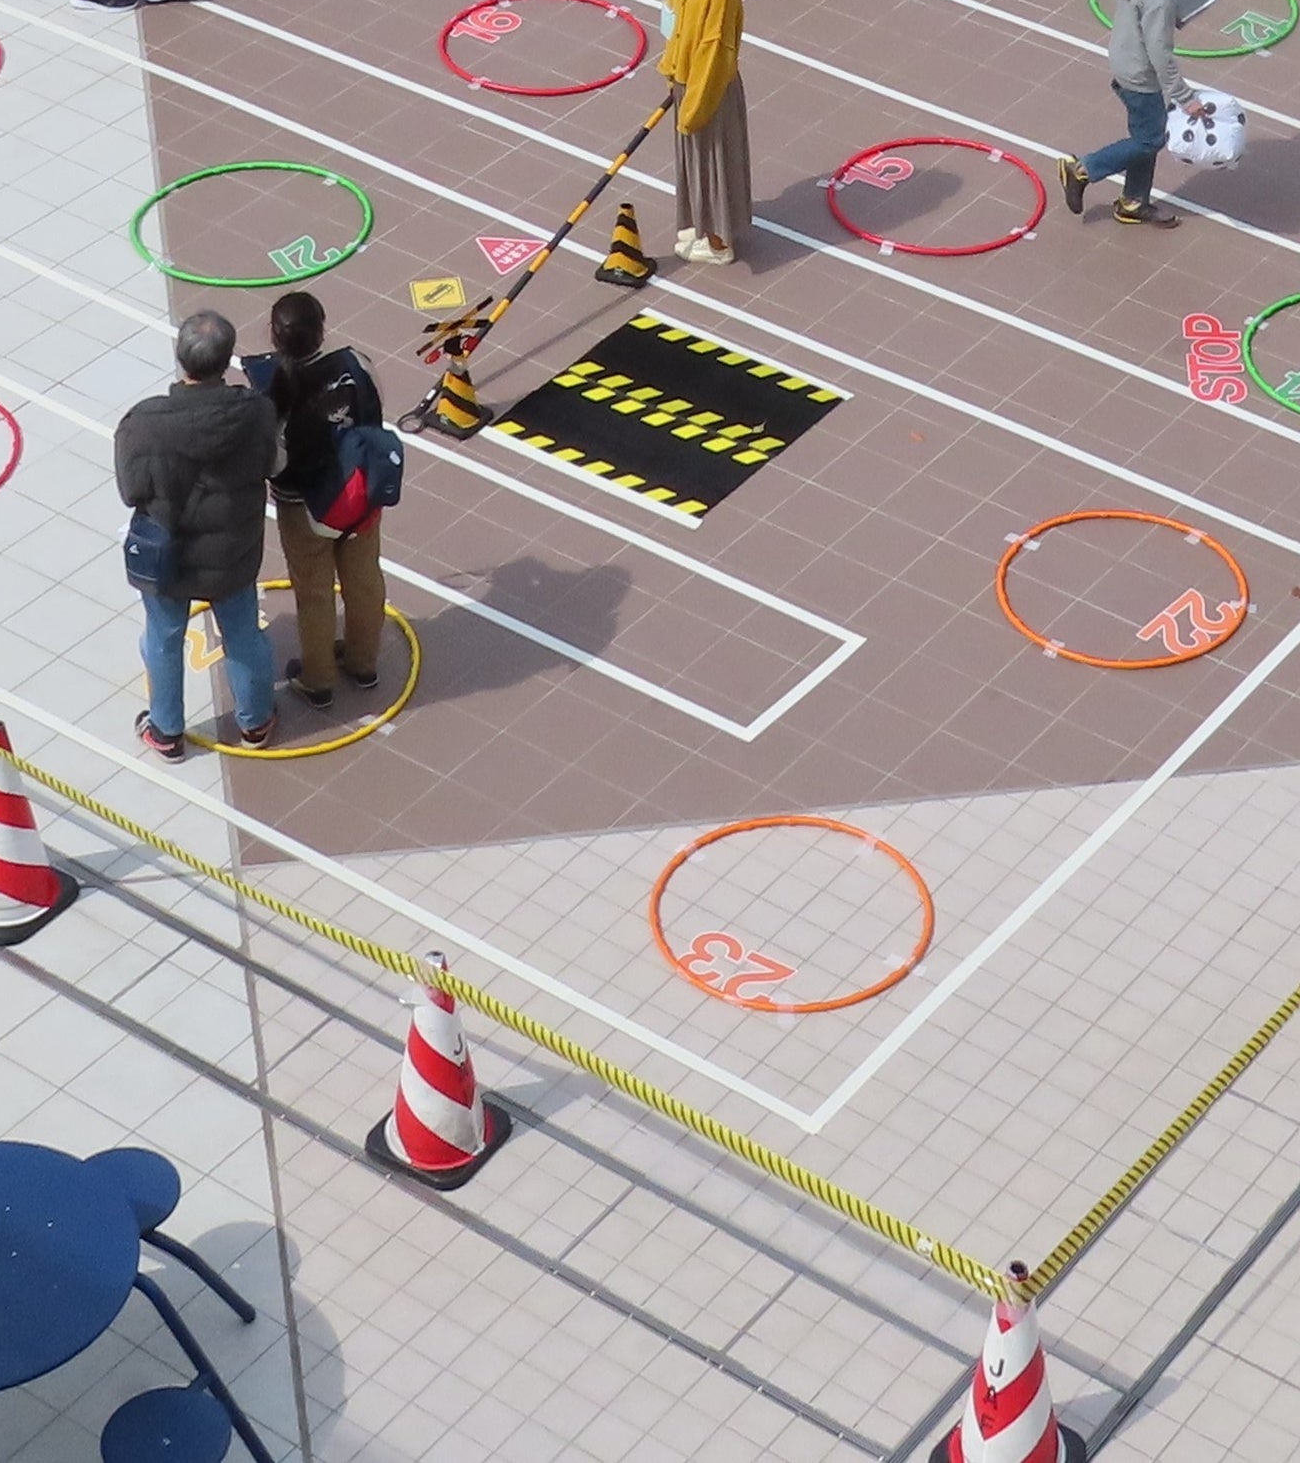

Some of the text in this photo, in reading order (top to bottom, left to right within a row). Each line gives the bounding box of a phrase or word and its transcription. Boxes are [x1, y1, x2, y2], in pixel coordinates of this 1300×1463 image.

[450, 7, 522, 44] 16
[1220, 10, 1290, 47] 12
[841, 154, 914, 190] 15
[267, 235, 344, 278] 21
[1182, 313, 1248, 404] STOP
[1136, 588, 1240, 656] 22
[679, 931, 797, 1004] 23
